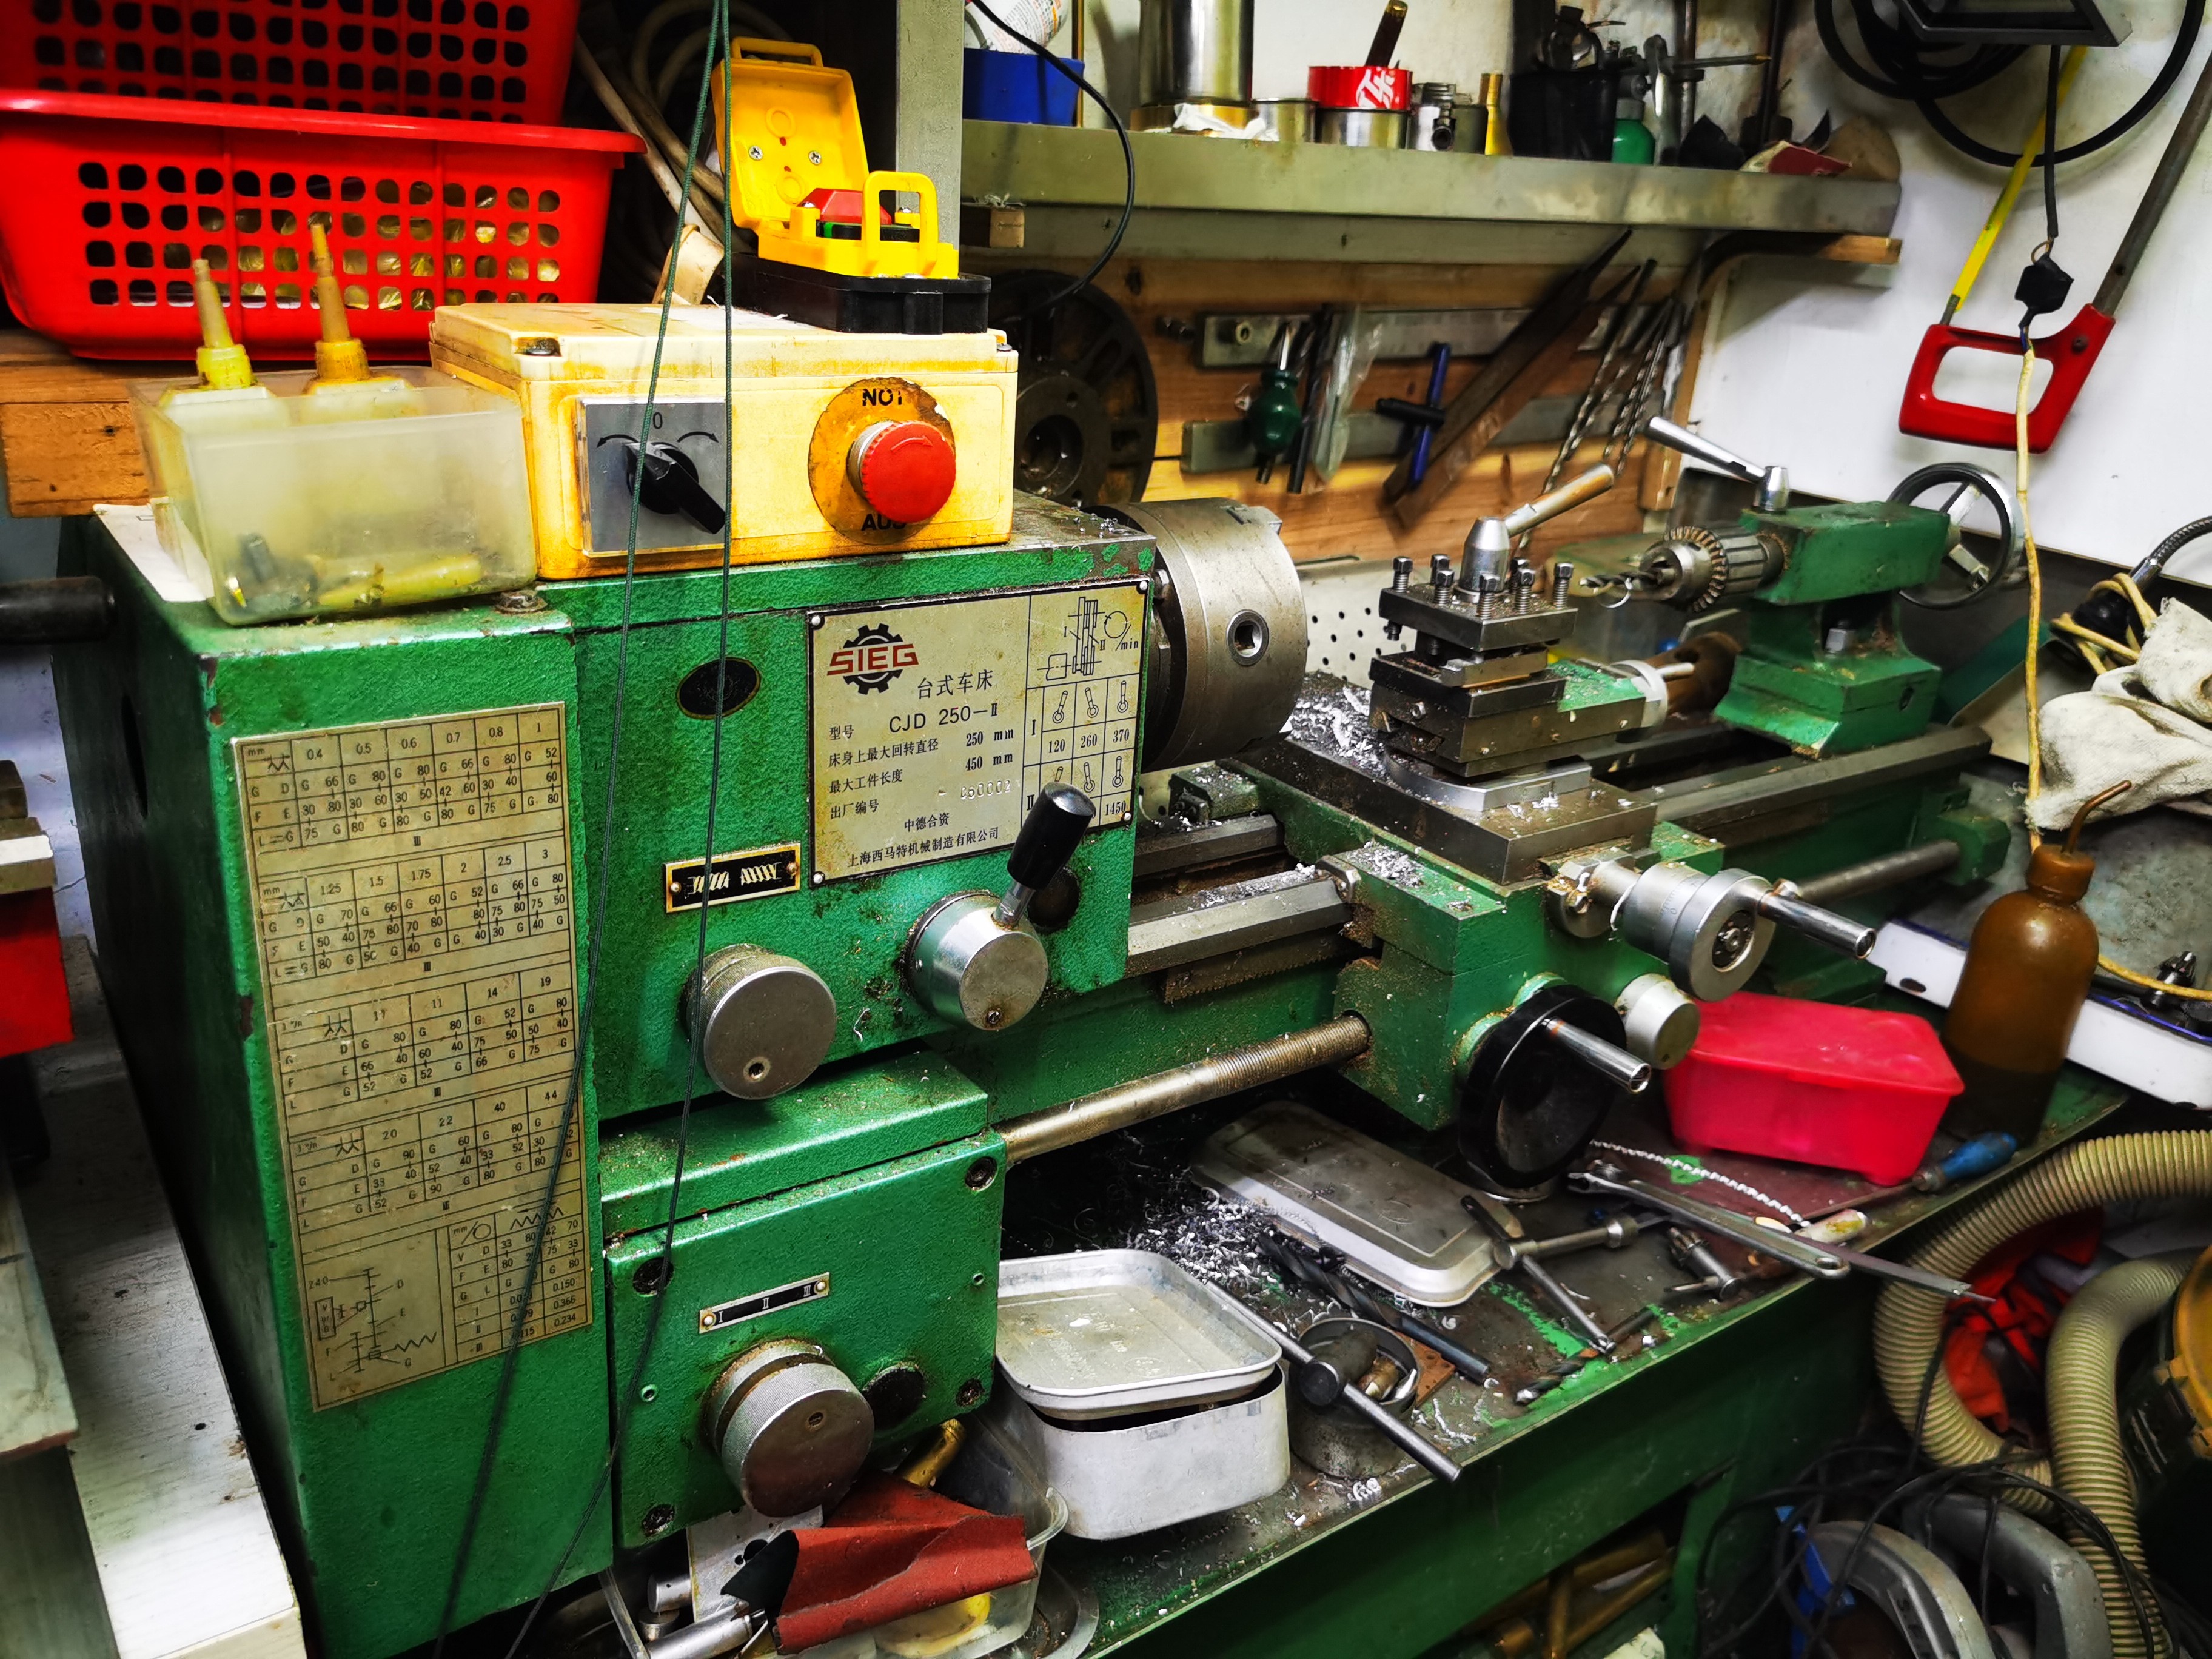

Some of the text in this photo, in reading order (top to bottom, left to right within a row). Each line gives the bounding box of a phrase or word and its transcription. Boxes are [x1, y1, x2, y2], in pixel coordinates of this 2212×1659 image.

[653, 412, 663, 429] 0
[827, 643, 919, 676] SIEG
[917, 669, 993, 699] 台式车床
[307, 726, 503, 760] 0.4 0.5 0.6 0.7 0.8
[829, 725, 854, 740] 型号
[889, 713, 926, 732] CJD
[1048, 739, 1065, 754] 120
[1081, 734, 1097, 748] 260
[1113, 728, 1130, 742] 370
[326, 747, 557, 787] 66 G 80 G 80 G 66 G 80 G 52
[829, 729, 1013, 767] 床身上最大回转直径 250 mm
[303, 771, 557, 815] 30 80 30 60 30 50 42 60 30 40 60
[830, 753, 1013, 794] 最大工件长度 450 mm
[305, 793, 558, 839] 75 80 G 80 G 80 G 75 G G 80
[831, 799, 879, 819] 出厂编号
[904, 813, 950, 832] 中德合资
[1105, 801, 1126, 816] 1450
[848, 827, 999, 868] 上海西马特机械制造有限公司
[321, 849, 548, 896] 1.25 1.5 1.75 2 2.5 3
[341, 873, 563, 920] 70 66 G 60 G 52 G 66 G 80
[317, 895, 565, 947] 50 40 80 70 80 80 75 80 75 50
[318, 916, 563, 969] 80 40 G 40 30 G 40 G
[488, 976, 551, 998] 14 19
[361, 997, 567, 1049] G 80 G 80 52 G 80
[395, 1017, 568, 1064] 40 60 40 50 50 40
[343, 1037, 567, 1096] G 52 G G 75 G
[382, 1090, 557, 1140] 20 22 40 44
[374, 1118, 541, 1168] G G 60 G 80 G
[405, 1136, 545, 1179] 40 52 40 52 30
[375, 1156, 546, 1208] 52 80 G 80
[502, 1220, 578, 1250] 33 80 70
[502, 1239, 578, 1269] 80 75 33
[506, 1258, 579, 1287] G G 80
[553, 1278, 575, 1292] 0.150
[554, 1313, 576, 1327] 0.234
